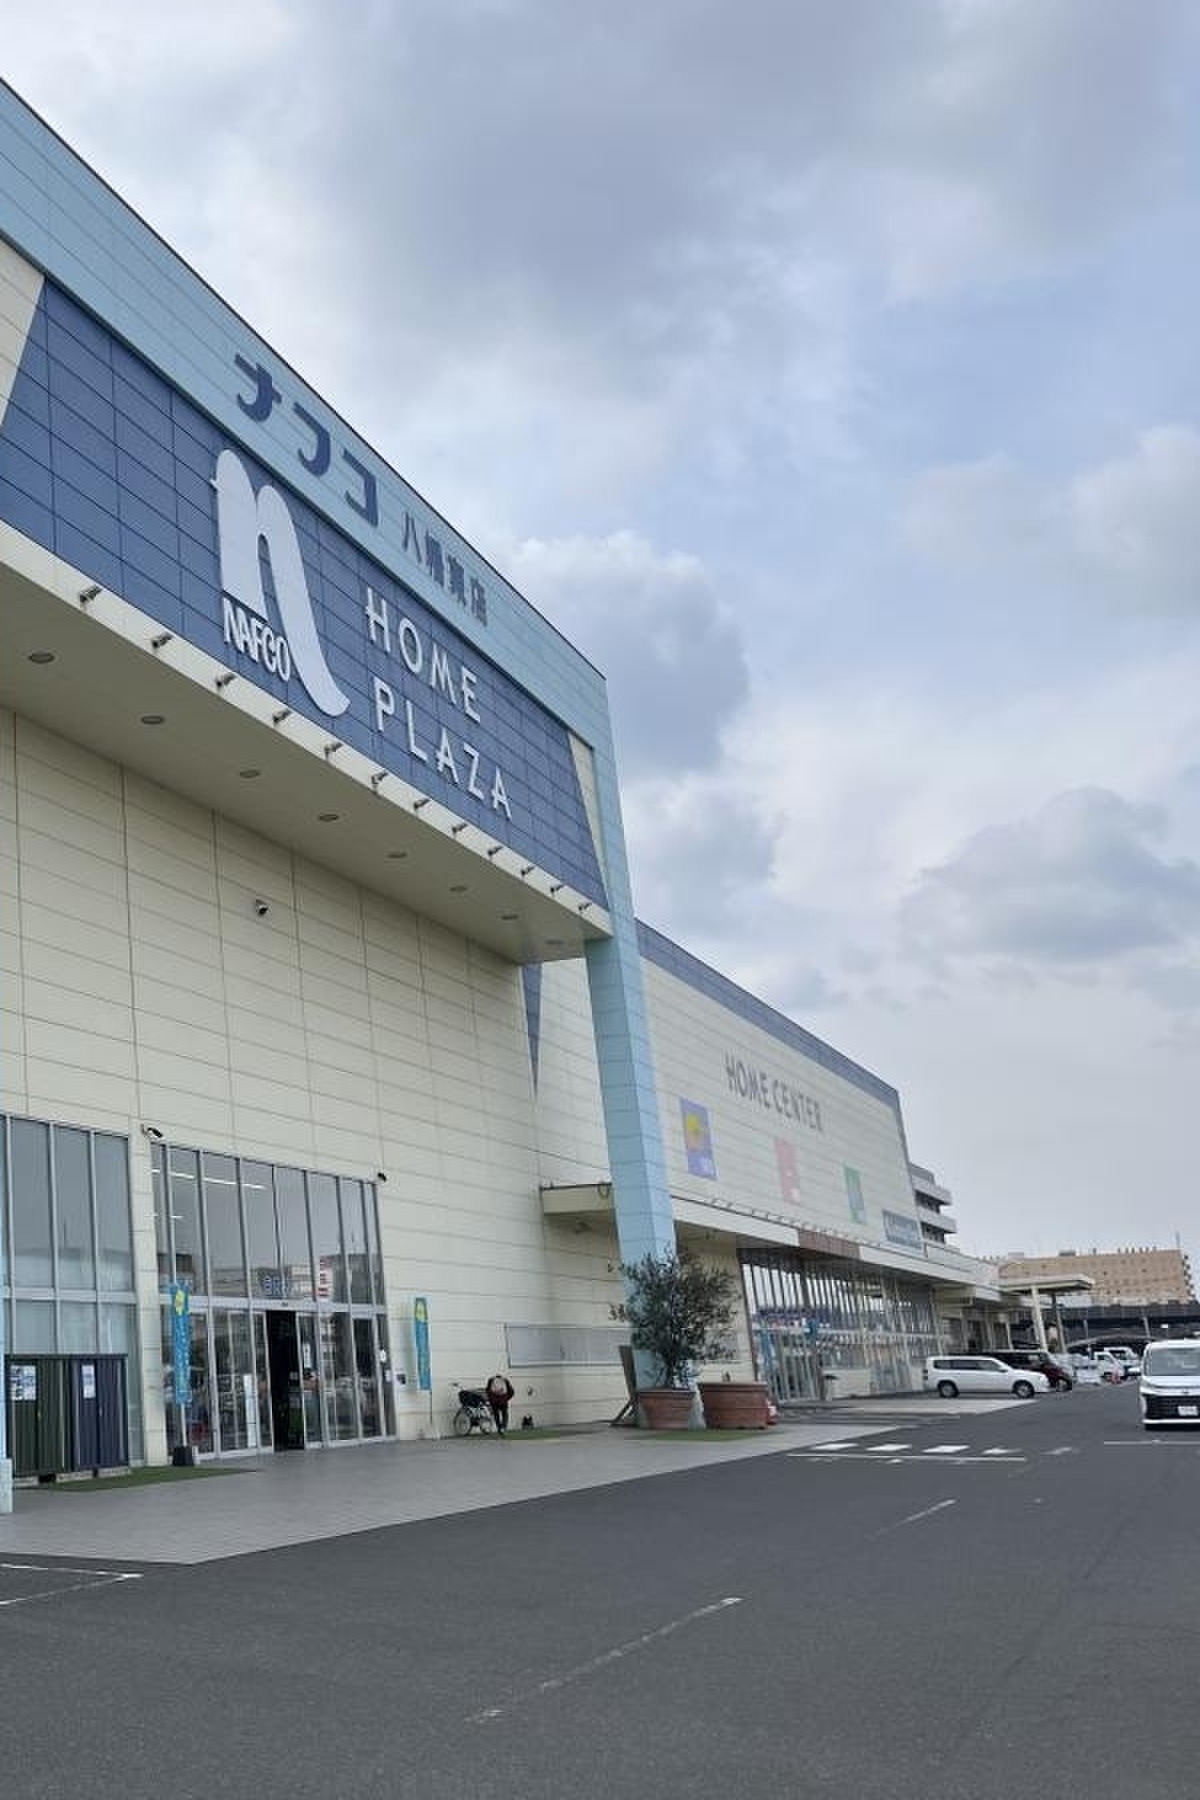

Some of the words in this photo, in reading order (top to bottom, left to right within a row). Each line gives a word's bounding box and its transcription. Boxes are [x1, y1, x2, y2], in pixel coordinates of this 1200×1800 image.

[235, 353, 379, 527] ナフコ
[223, 597, 291, 683] NAFCO
[365, 586, 482, 725] HOME
[372, 679, 514, 822] PLAZA
[725, 1052, 770, 1110] HOME
[772, 1079, 824, 1133] CENTER
